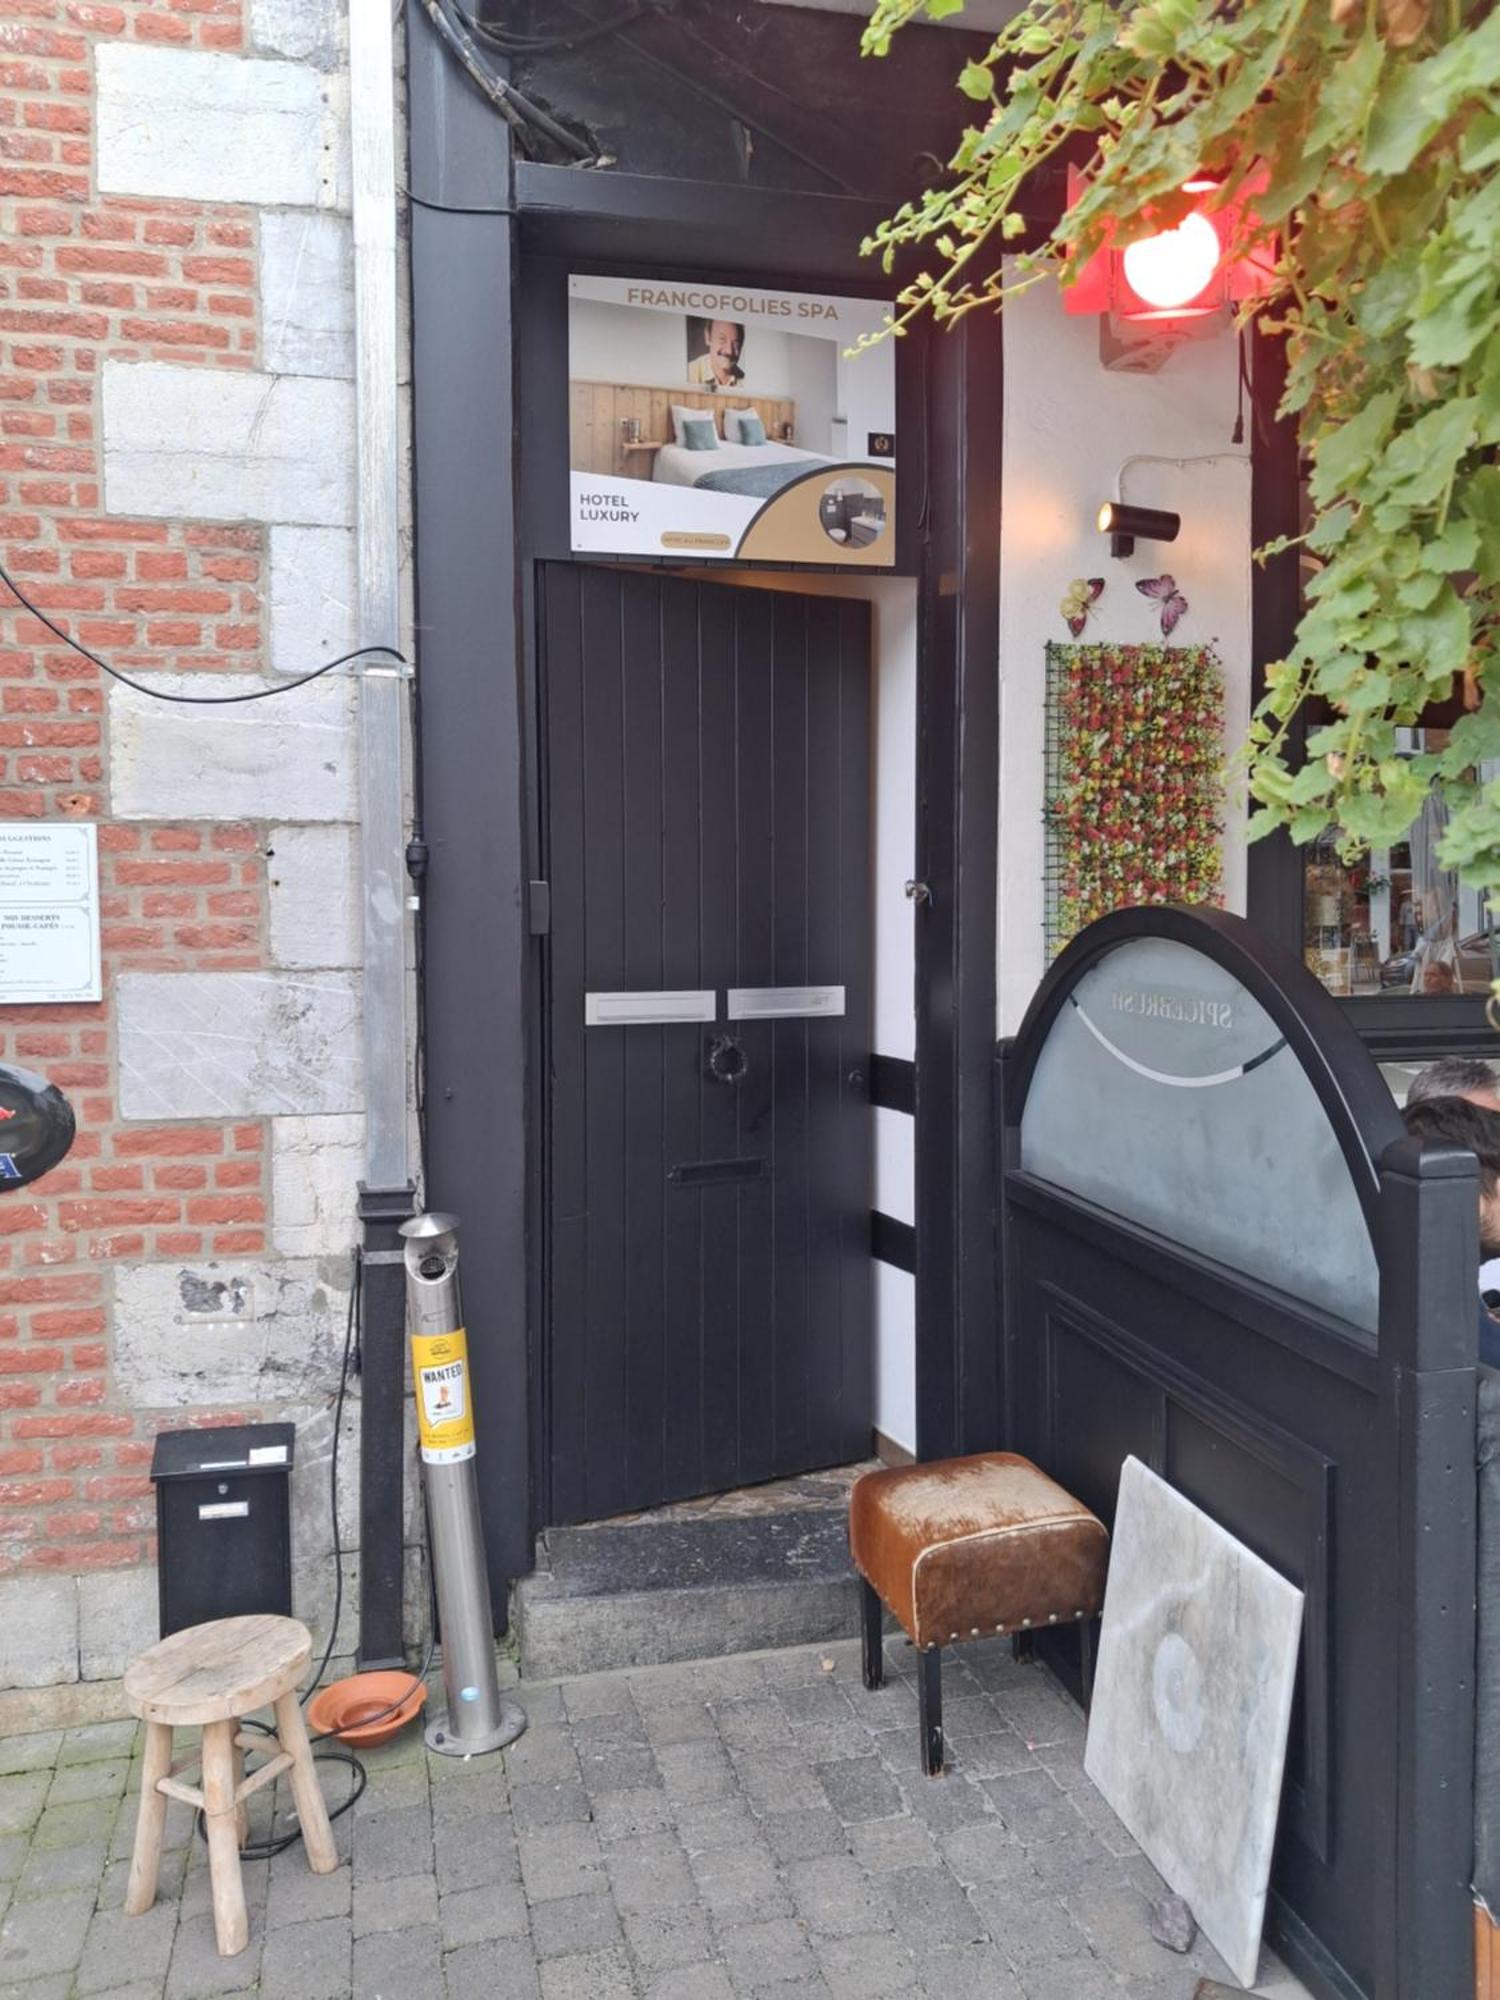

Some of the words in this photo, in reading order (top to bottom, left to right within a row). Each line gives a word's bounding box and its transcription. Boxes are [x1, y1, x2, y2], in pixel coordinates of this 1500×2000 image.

[627, 287, 792, 317] FRANCOFOLIES
[797, 302, 840, 321] SPA
[579, 493, 630, 508] HOTEL
[579, 508, 640, 523] LUXURY
[423, 1363, 463, 1384] WANTED
